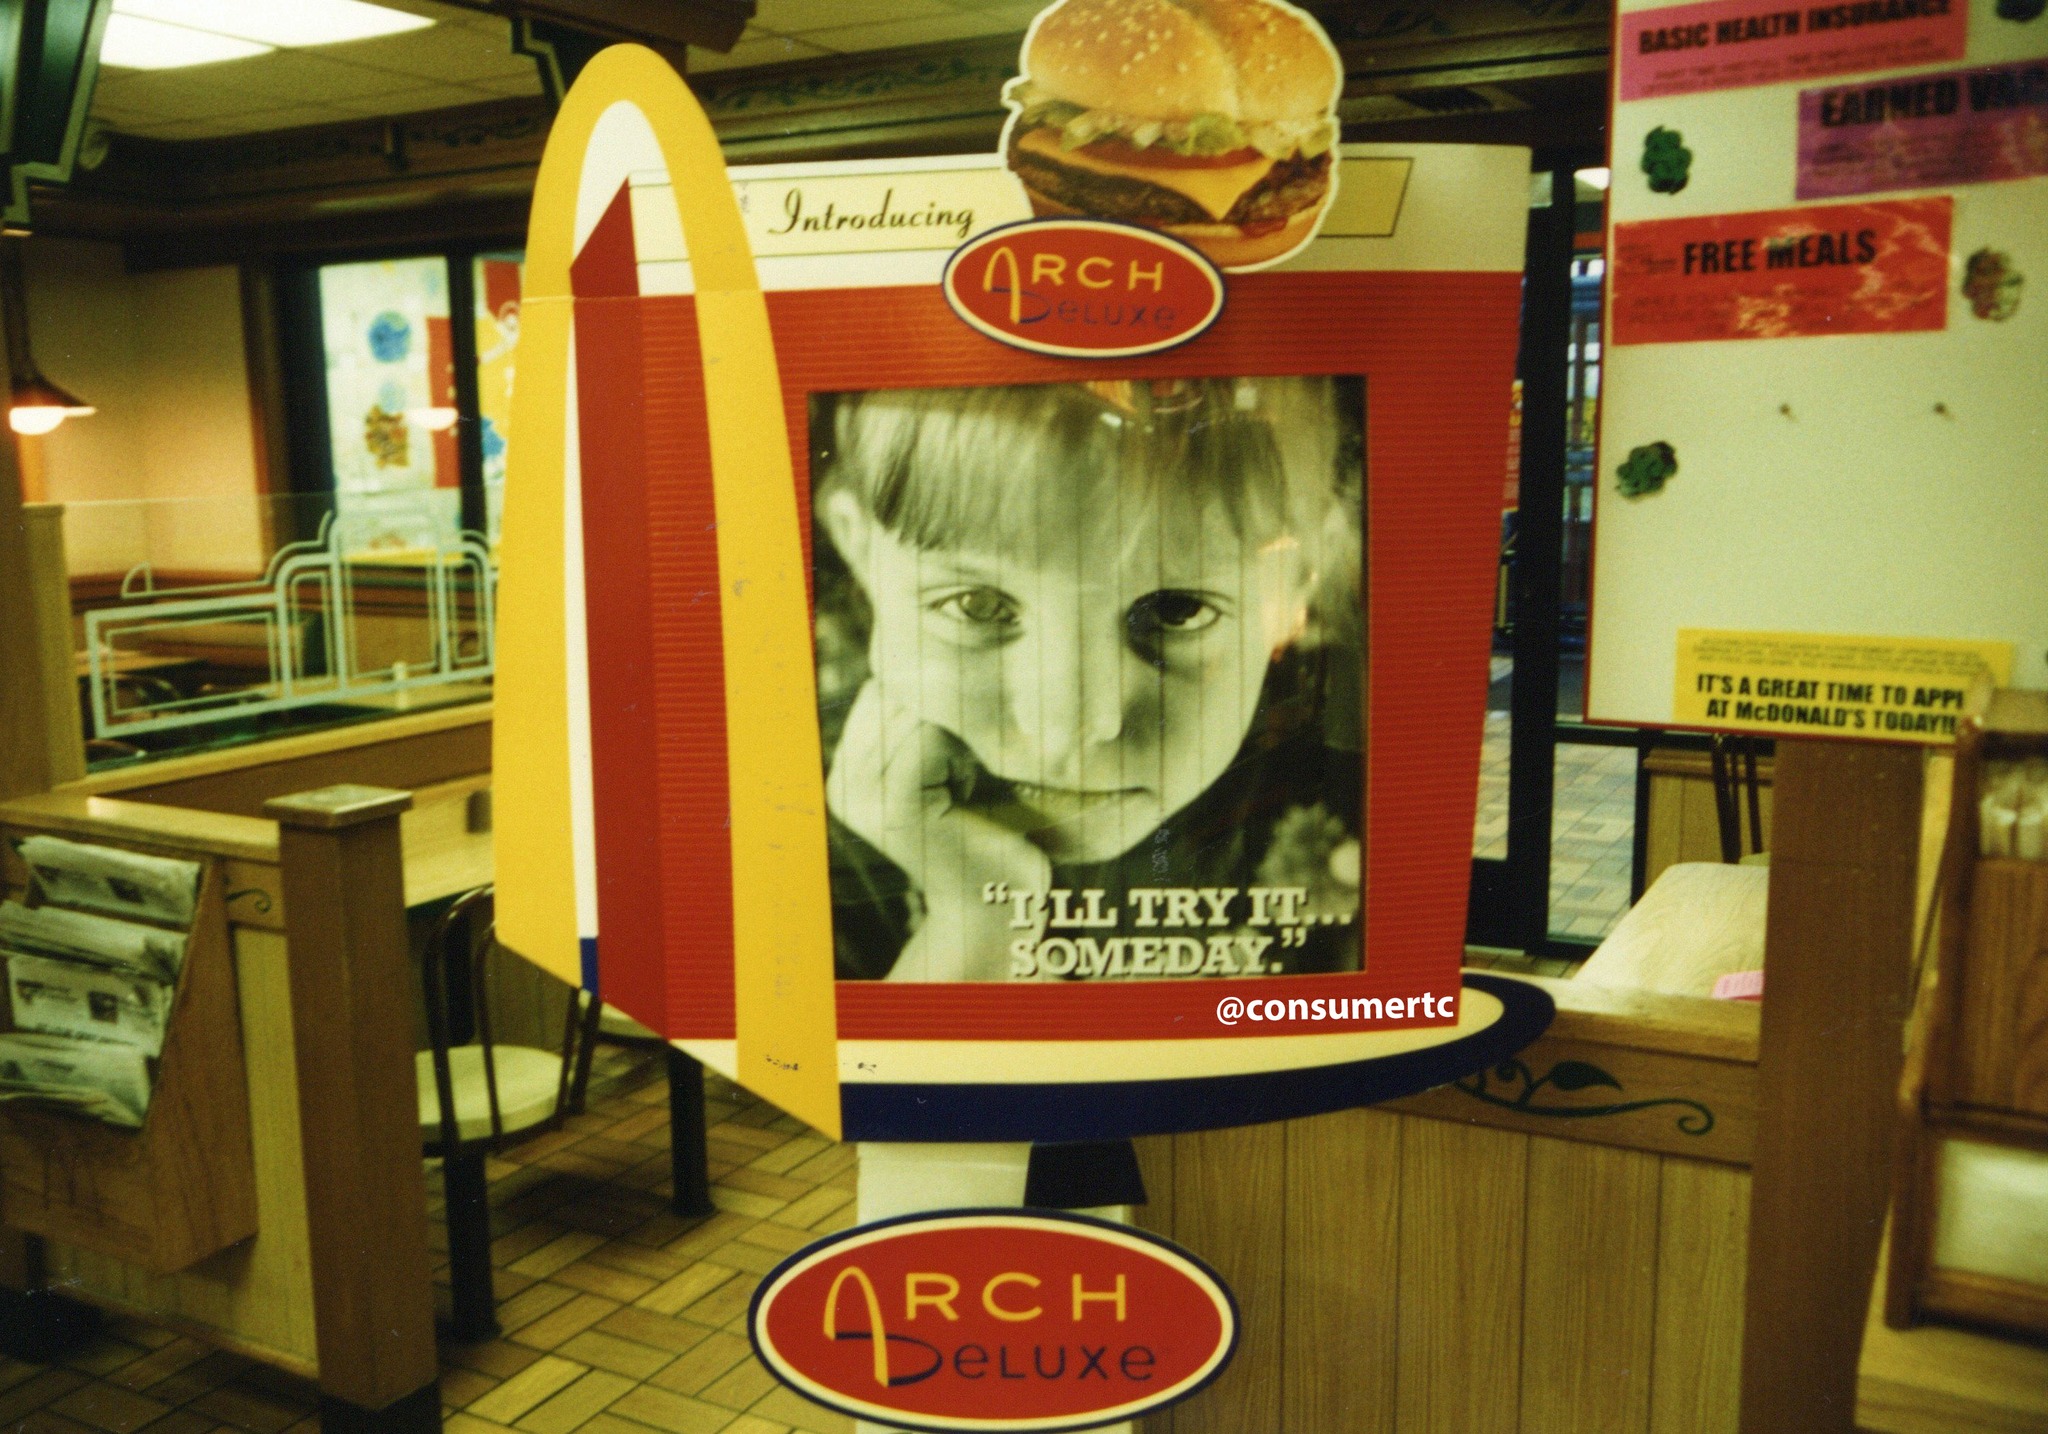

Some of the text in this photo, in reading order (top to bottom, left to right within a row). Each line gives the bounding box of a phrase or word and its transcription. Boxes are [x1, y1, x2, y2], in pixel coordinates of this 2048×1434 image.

[1638, 22, 1710, 54] BASIC
[1715, 9, 1799, 45] HEALTH
[1821, 77, 1958, 128] EARNED
[768, 188, 975, 237] Introducing
[1684, 239, 1755, 276] FREE
[1766, 229, 1877, 270] MEALS
[983, 246, 1164, 325] ARCH
[1697, 673, 1733, 694] IT'S
[1739, 676, 1750, 695] A
[1757, 677, 1818, 699] GREAT
[1827, 682, 1873, 703] TIME
[1882, 685, 1906, 706] TO
[1706, 699, 1729, 719] AT
[1736, 701, 1865, 730] McDONALD'S
[1128, 887, 1239, 927] TRY
[823, 1266, 1127, 1388] ARCH
